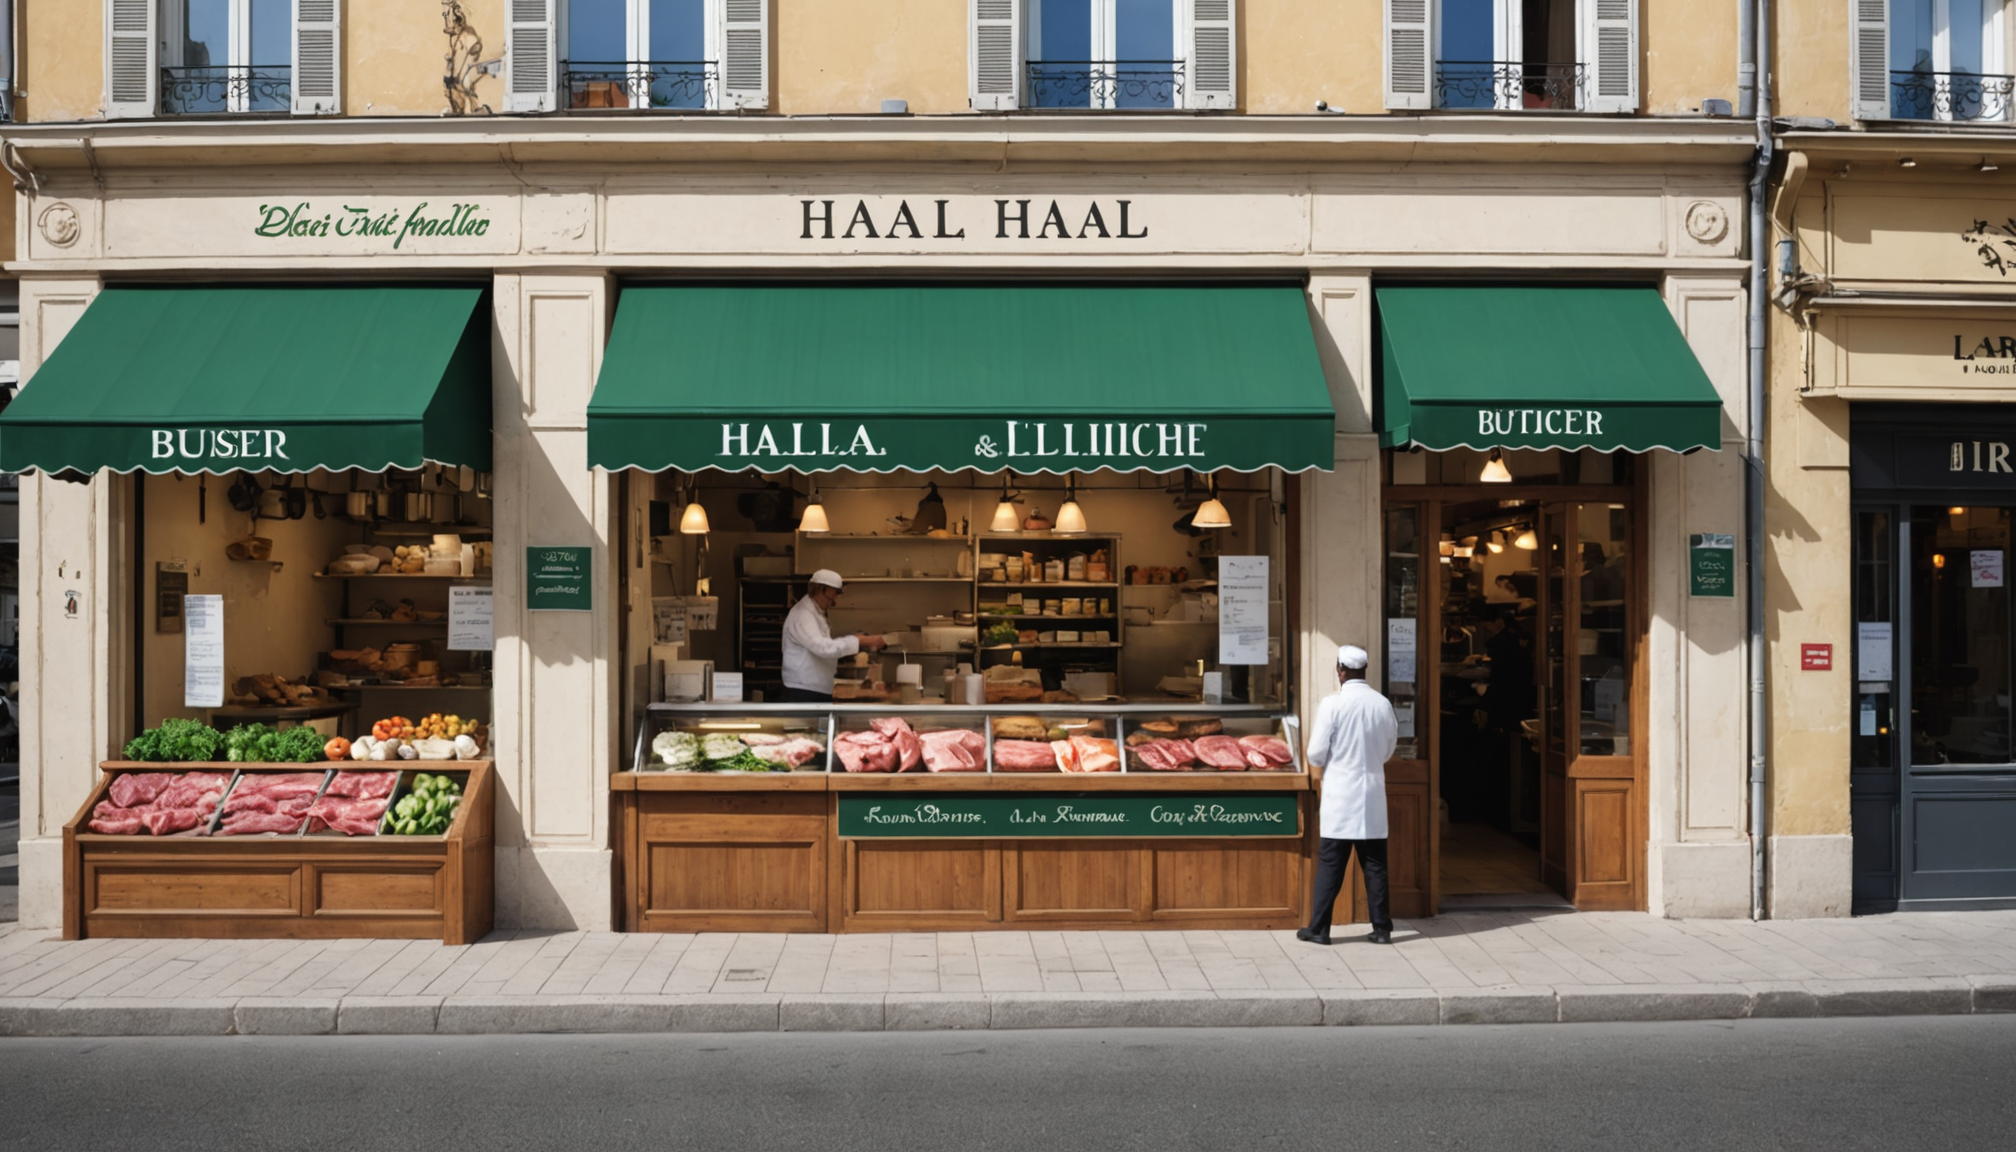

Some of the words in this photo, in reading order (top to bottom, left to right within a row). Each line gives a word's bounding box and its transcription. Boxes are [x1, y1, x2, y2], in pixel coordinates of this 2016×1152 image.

[800, 199, 965, 240] HAAL
[994, 199, 1148, 239] HAAL
[1478, 409, 1604, 435] BUTICER
